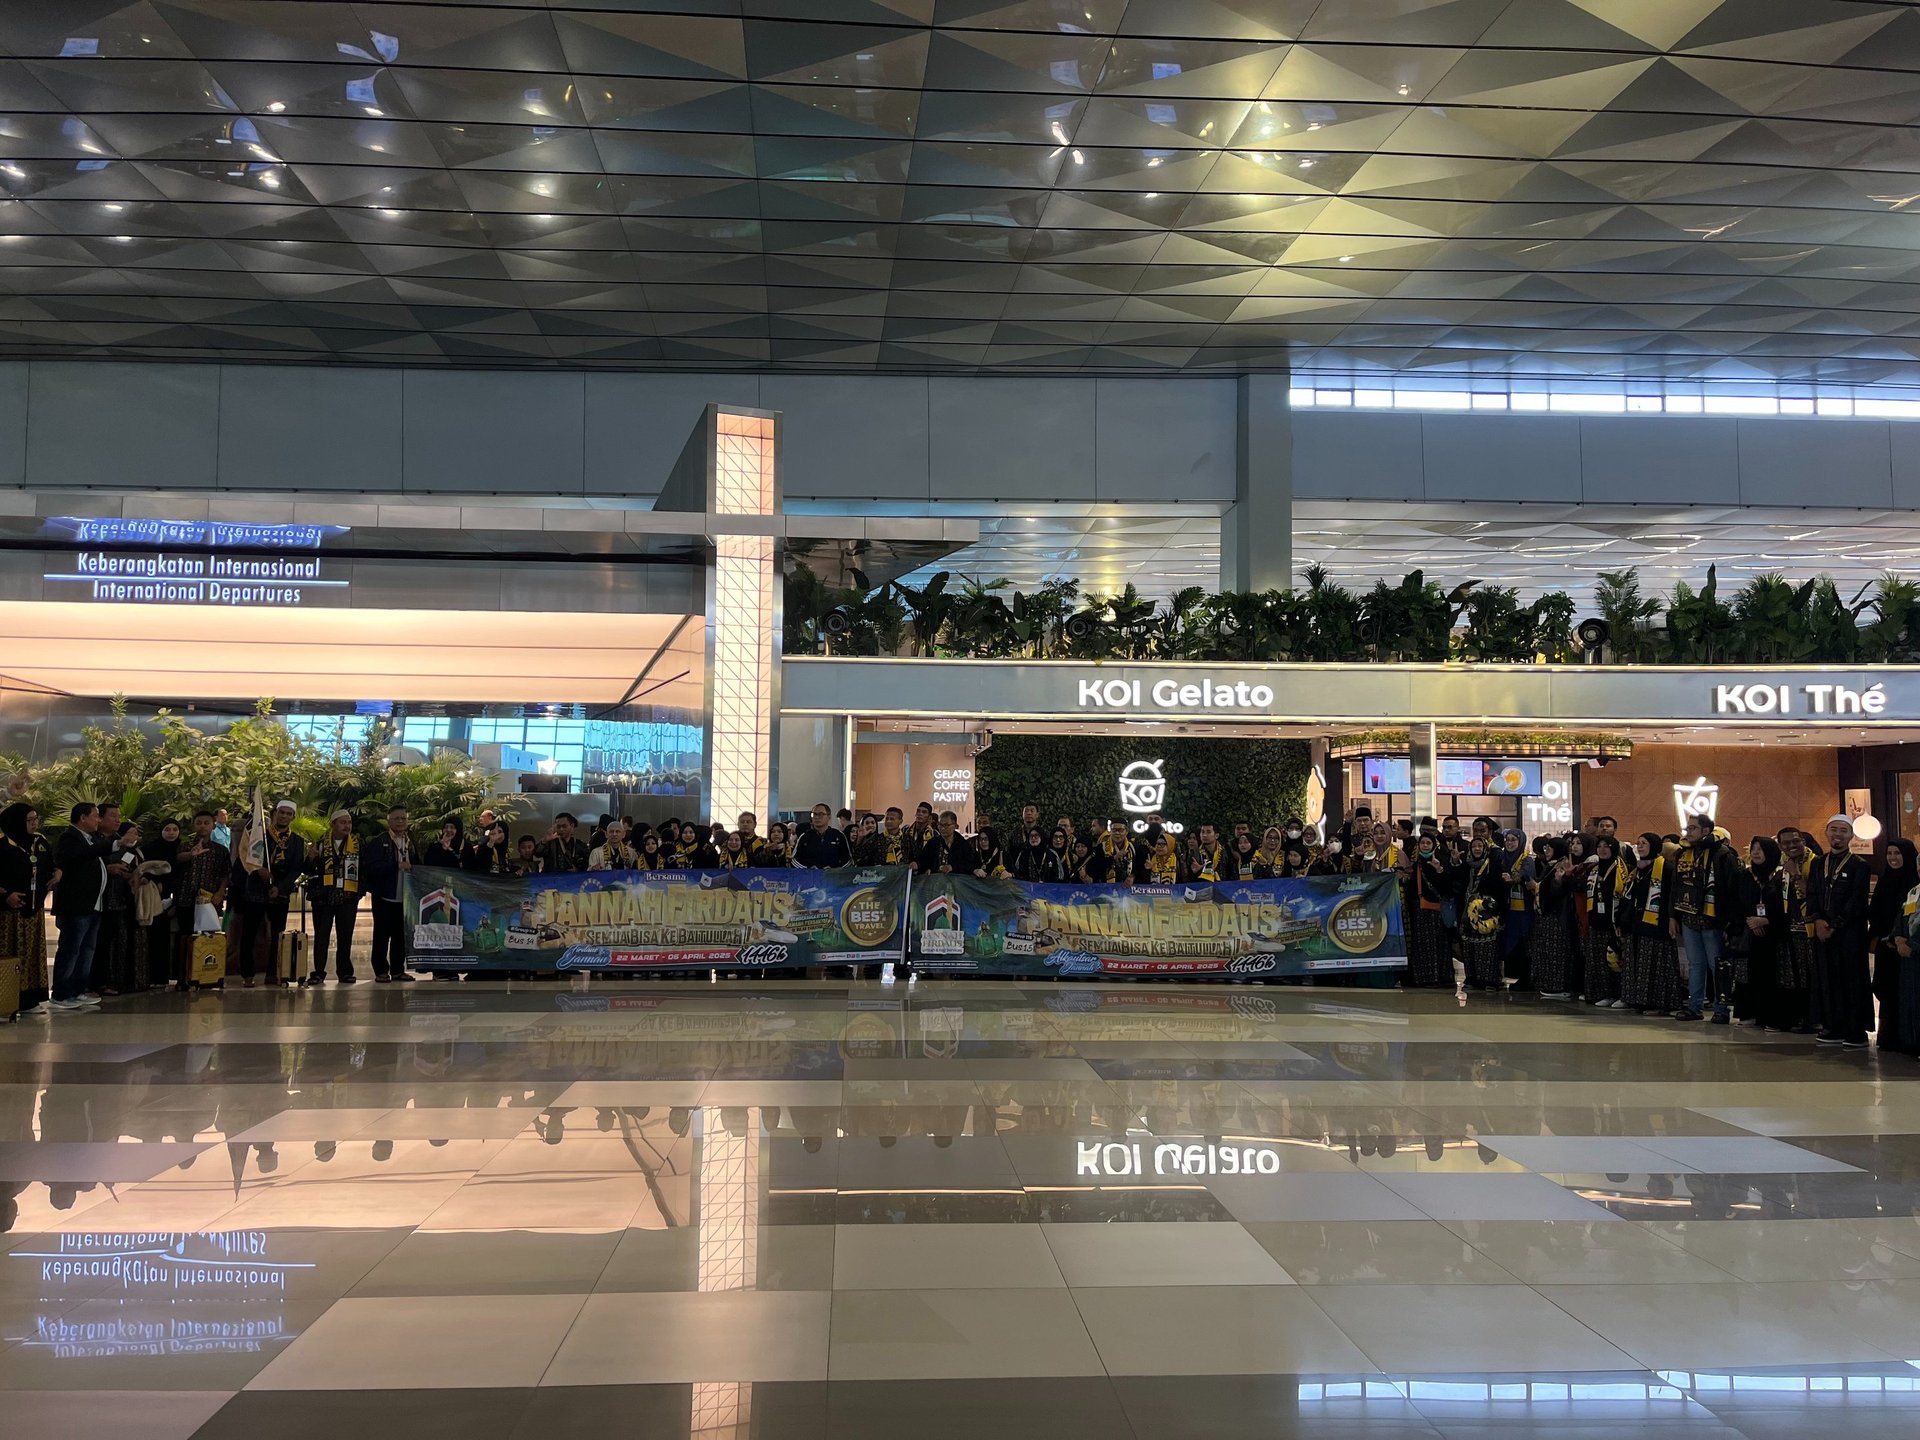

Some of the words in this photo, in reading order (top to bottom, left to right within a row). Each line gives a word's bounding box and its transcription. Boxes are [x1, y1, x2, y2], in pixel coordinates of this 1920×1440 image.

[78, 552, 204, 576] Keberangkatan
[210, 555, 320, 577] Internasional
[93, 580, 204, 601] International
[209, 583, 301, 605] Departures
[1078, 679, 1141, 706] KOI
[1152, 678, 1274, 707] Gelato
[1717, 684, 1790, 713] KOI
[1805, 682, 1886, 713] Thé
[933, 769, 971, 779] GELATO
[933, 780, 971, 790] COFFEE
[933, 792, 968, 802] PASTRY
[1526, 802, 1571, 822] Thé
[645, 872, 688, 882] Bersama
[1131, 886, 1172, 896] Bersama
[534, 888, 665, 926] JANNAH
[666, 884, 795, 927] FIRDAUS
[860, 901, 881, 910] THE
[1033, 899, 1150, 936] JANNAH
[1151, 897, 1281, 938] FIRDAUS
[1346, 909, 1366, 917] THE
[508, 936, 524, 944] Bus
[586, 929, 627, 945] SEMUA
[630, 928, 658, 945] BISA
[661, 928, 676, 944] KE
[1006, 942, 1022, 951] Bus
[1023, 944, 1033, 952] 15
[1078, 939, 1119, 953] SEMUA
[1121, 939, 1149, 955] BISA
[1150, 940, 1166, 956] KE
